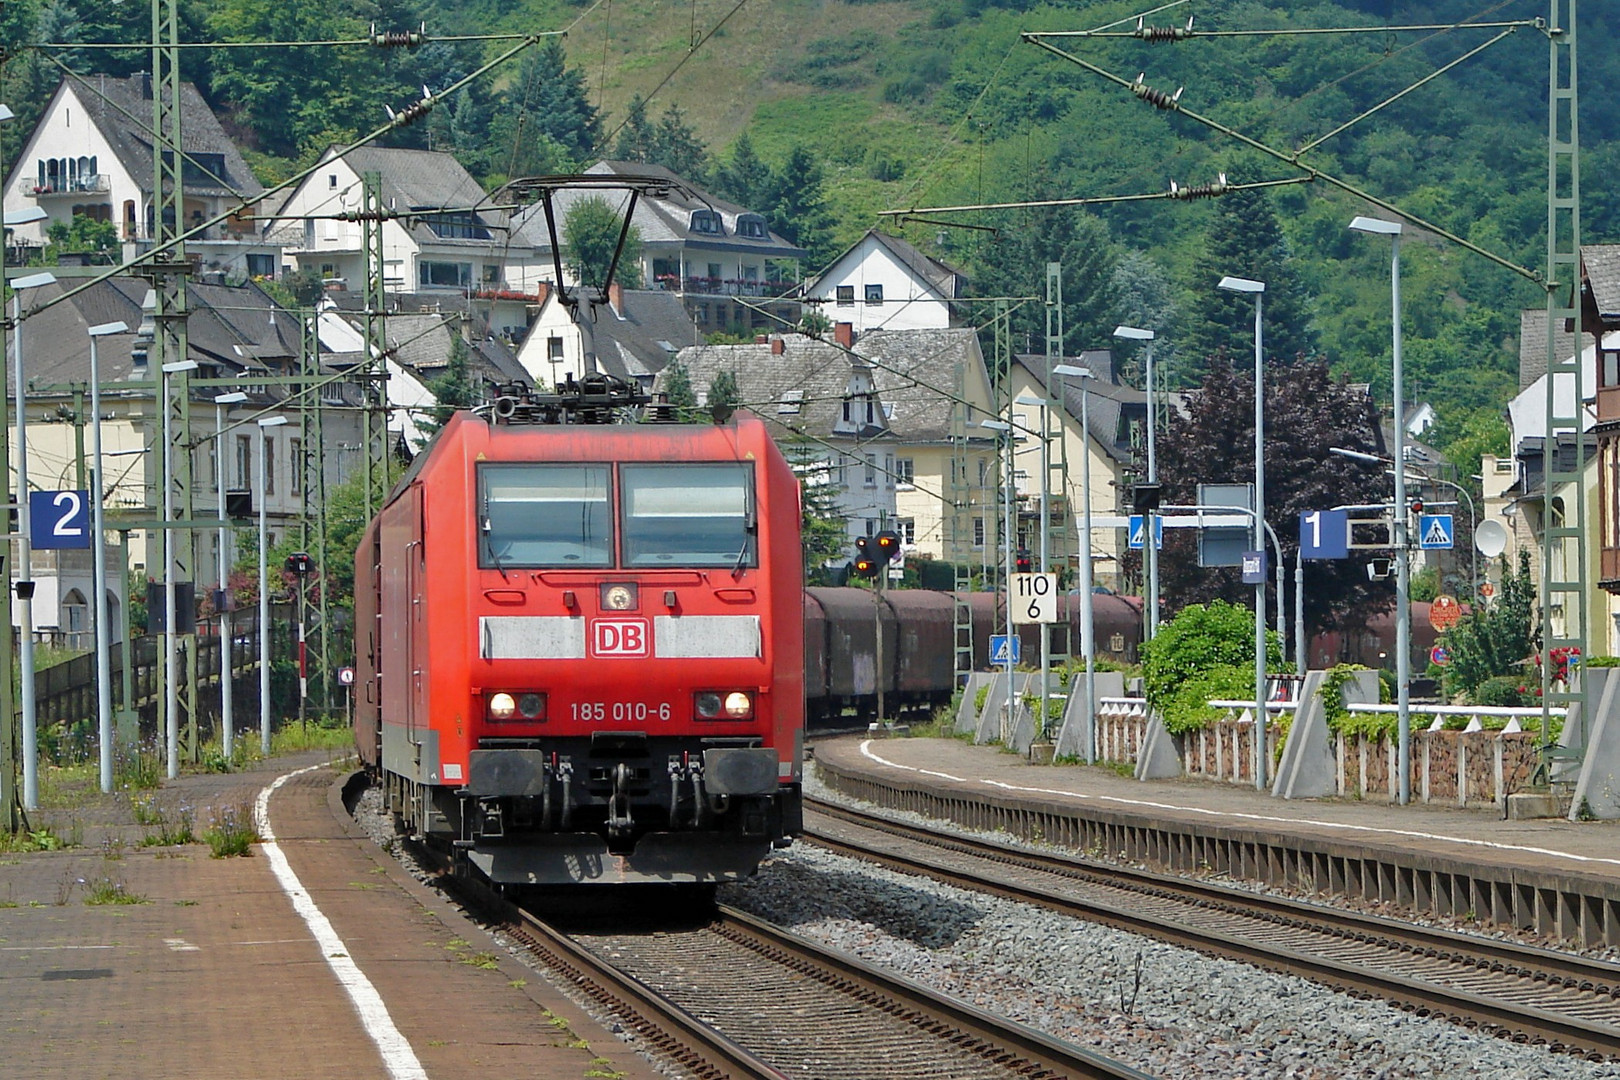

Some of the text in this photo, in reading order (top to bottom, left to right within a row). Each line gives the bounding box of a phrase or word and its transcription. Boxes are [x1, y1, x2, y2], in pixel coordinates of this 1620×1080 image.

[53, 491, 82, 536] 2
[1305, 511, 1320, 548] 1
[1017, 576, 1049, 596] 110
[1027, 598, 1041, 618] 6
[599, 625, 642, 651] DB
[1112, 637, 1124, 650] 10
[571, 702, 671, 721] 185 010-6
